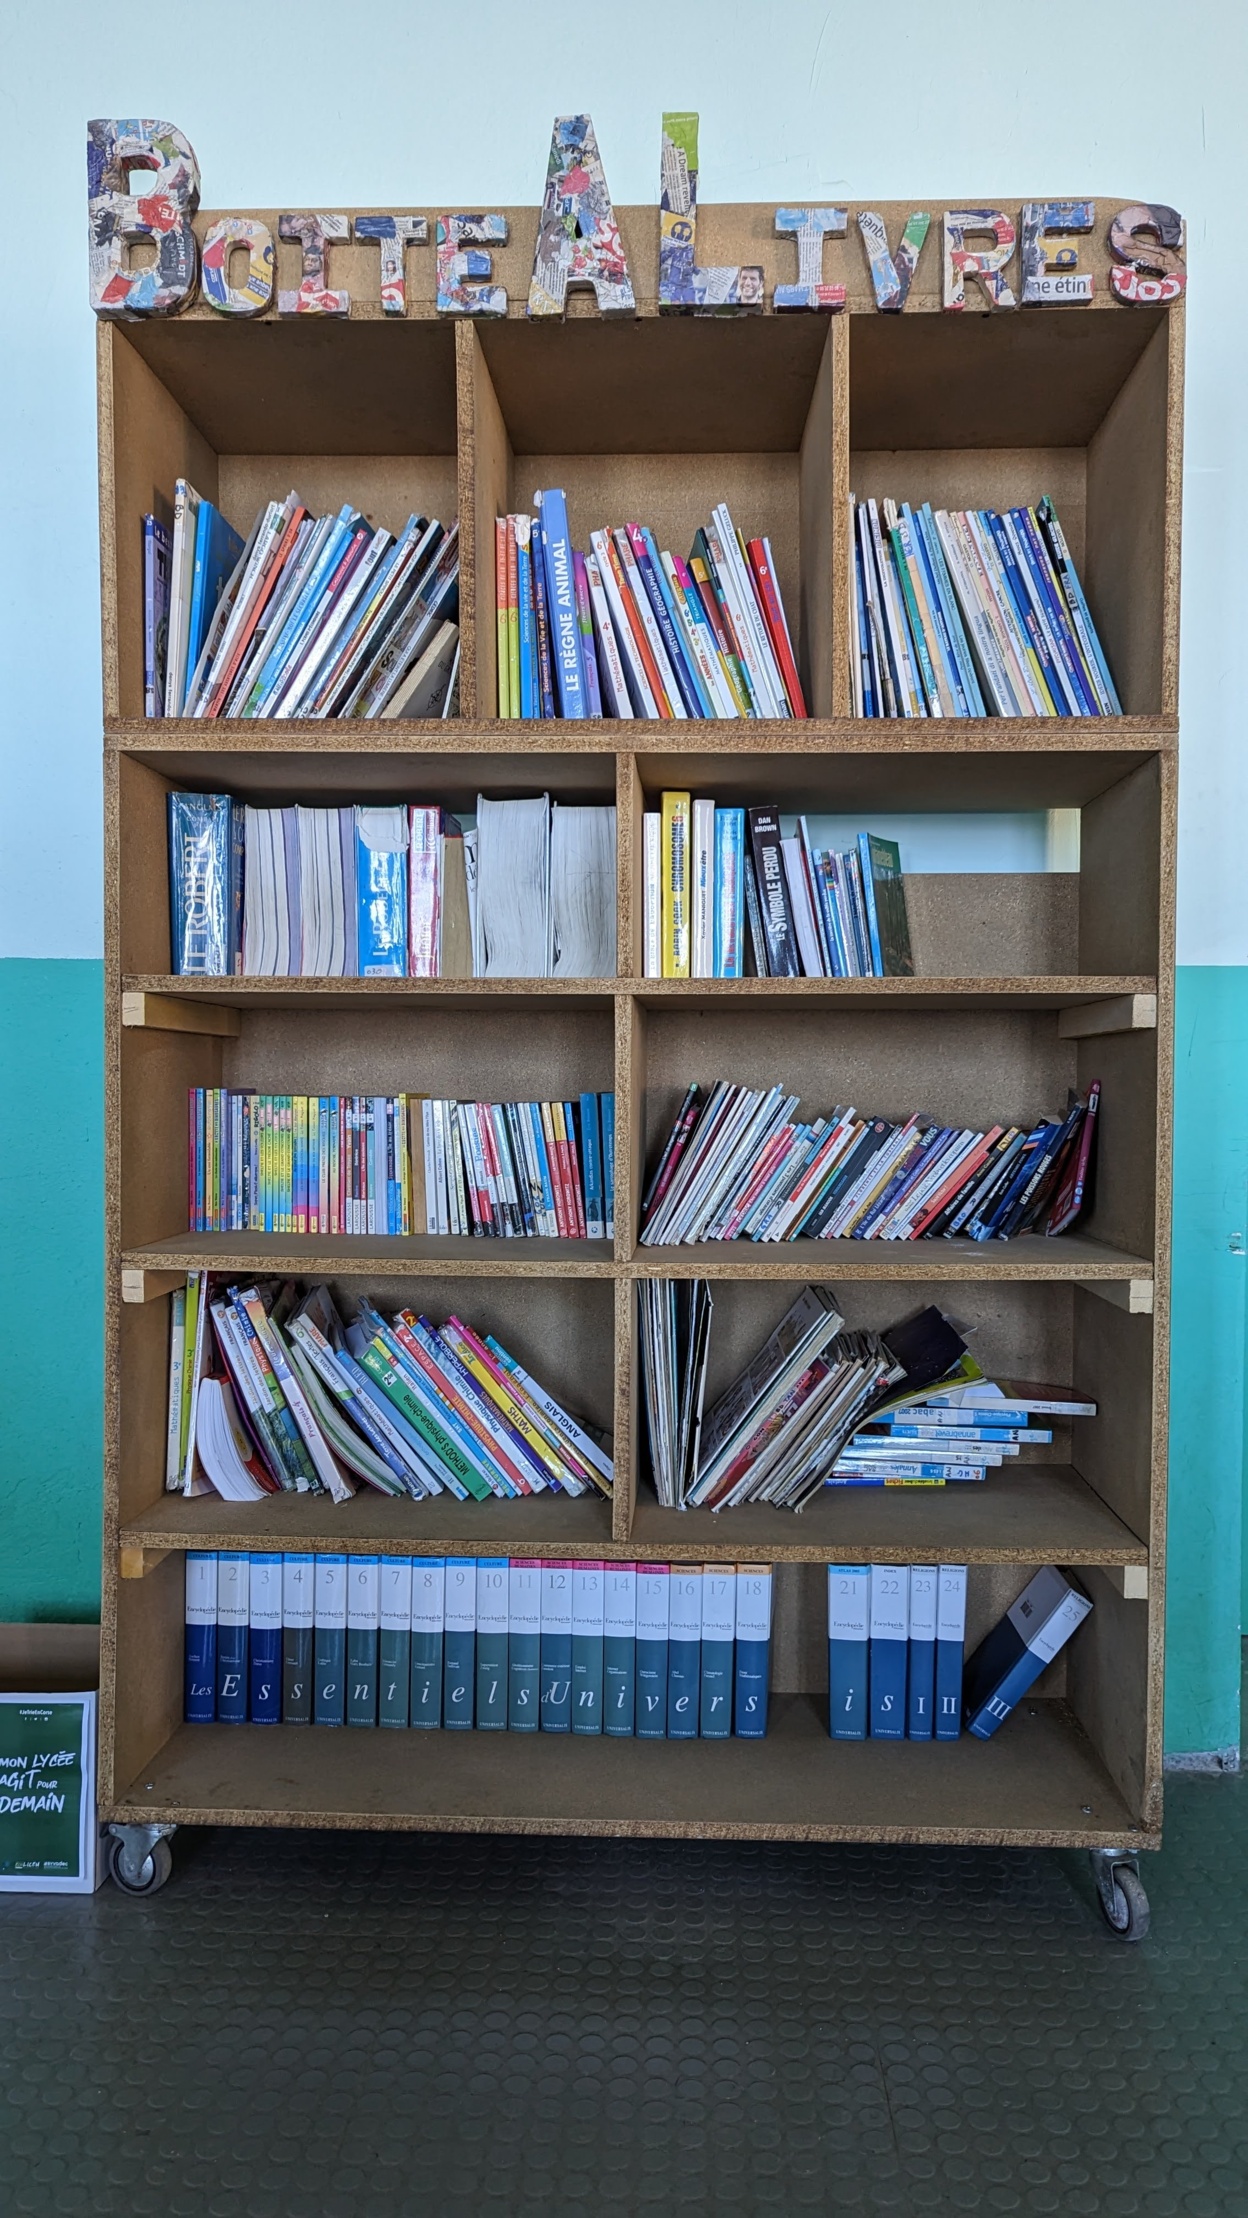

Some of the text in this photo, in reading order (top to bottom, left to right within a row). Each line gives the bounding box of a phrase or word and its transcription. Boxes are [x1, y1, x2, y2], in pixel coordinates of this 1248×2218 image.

[678, 159, 687, 185] Dream
[552, 538, 579, 690] LE RÈGNE ANIMAL
[645, 566, 679, 653] HISTOIRE GÉOGRAPHIE
[755, 816, 777, 832] DAN BROWN
[761, 846, 788, 941] LE SYMBOLE PERDU
[919, 1126, 938, 1147] VOUS
[1018, 1153, 1052, 1204] LES POISSONS ROUGES
[408, 1341, 434, 1369] ESPACE
[433, 1335, 469, 1377] HYPERBOLE
[315, 1357, 339, 1385] Français
[453, 1374, 500, 1433] Physique Chimie
[506, 1406, 532, 1434] MATHS
[542, 1401, 580, 1439] ANGLAIS
[402, 1392, 469, 1476] METHOD'S physique-chimie
[934, 1429, 975, 1438] annabrevet
[199, 1566, 205, 1580] 1
[228, 1568, 238, 1581] 2
[260, 1570, 270, 1584] 3
[293, 1570, 303, 1583] 4
[325, 1570, 334, 1584] 5
[358, 1571, 367, 1585] 6
[391, 1571, 400, 1585] 7
[424, 1574, 432, 1587] 8
[456, 1572, 465, 1586] 9
[485, 1574, 502, 1589] 10
[518, 1574, 532, 1589] 11
[549, 1575, 566, 1589] 12
[581, 1576, 598, 1591] 13
[613, 1577, 630, 1591] 14
[645, 1580, 662, 1595] 15
[678, 1580, 695, 1595] 16
[710, 1580, 727, 1595] 17
[745, 1581, 761, 1595] 18
[840, 1581, 857, 1595] 21
[880, 1580, 900, 1594] 22
[915, 1581, 931, 1593] 23
[944, 1580, 960, 1593] 24
[1062, 1605, 1080, 1622] 25
[833, 1621, 863, 1630] Encyclopédie
[874, 1621, 904, 1630] Encyclopédie
[190, 1683, 212, 1696] Les
[941, 1697, 957, 1714] II
[985, 1695, 1013, 1721] III
[0, 1750, 76, 1768] MON LYCÉE
